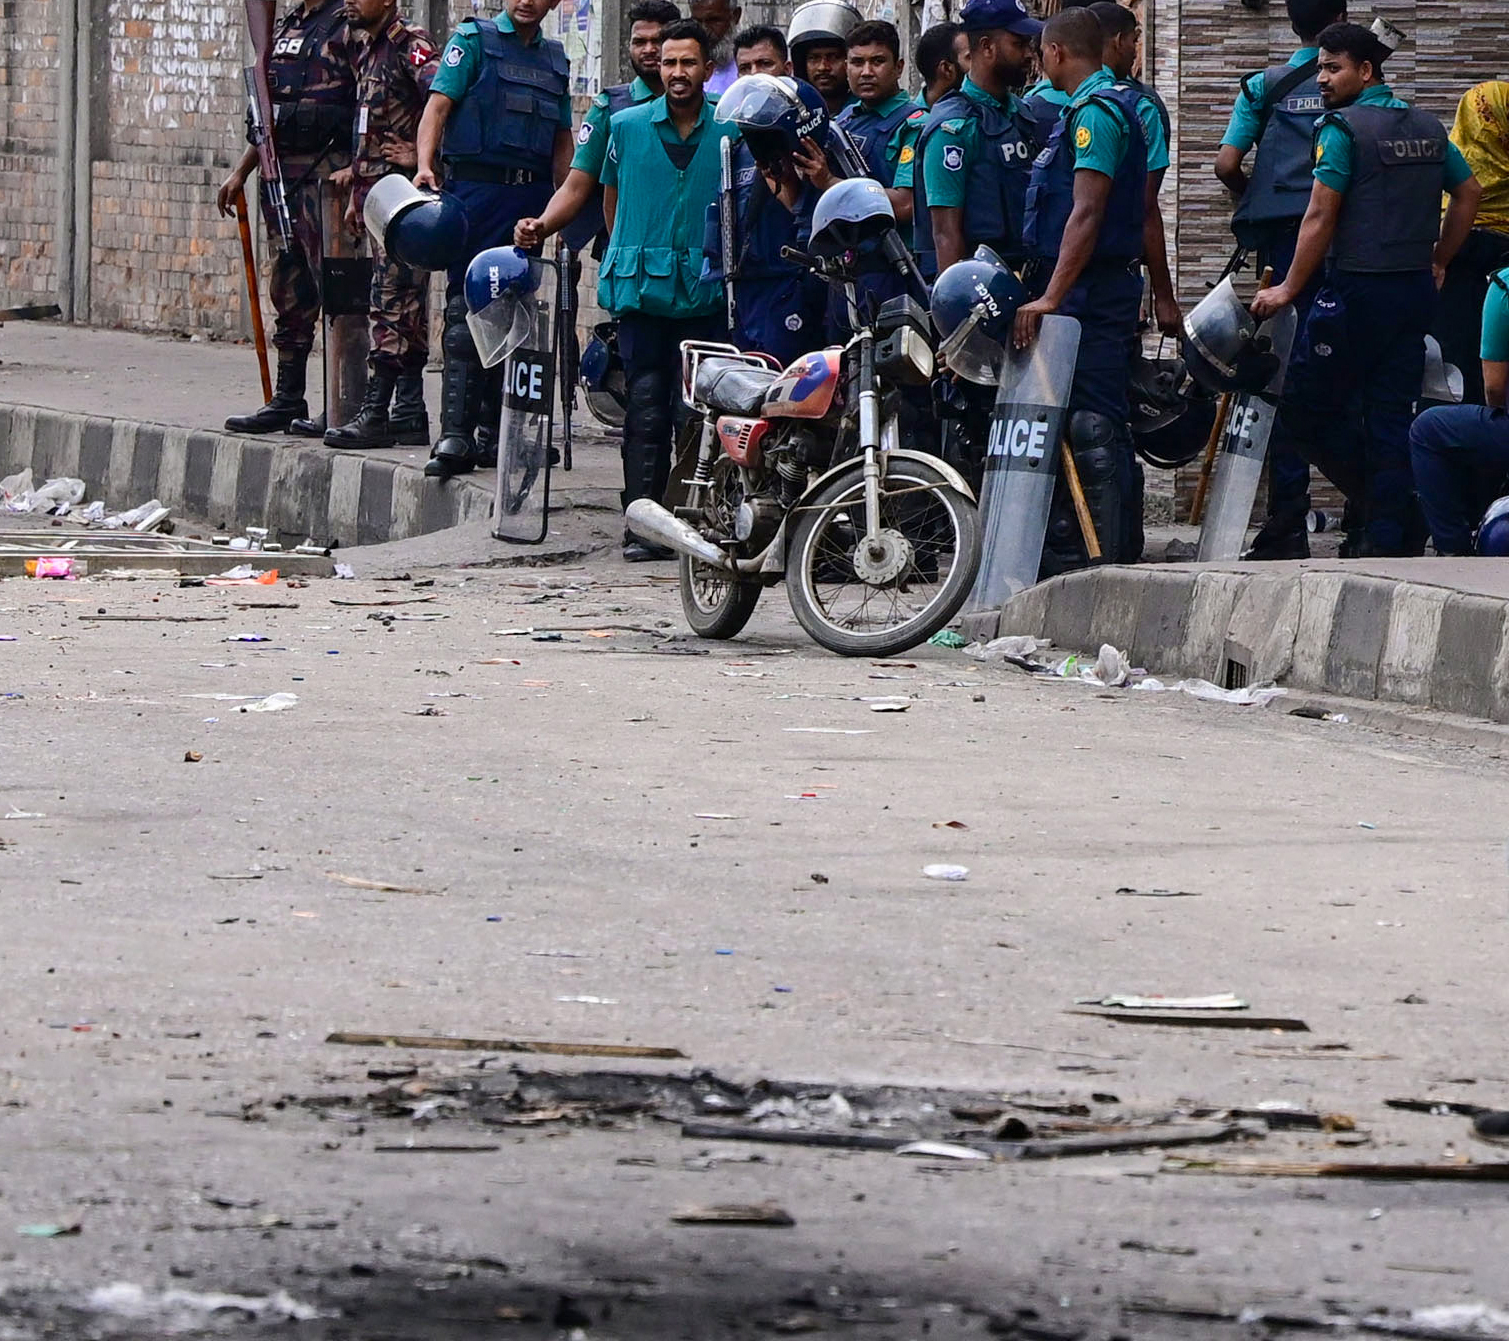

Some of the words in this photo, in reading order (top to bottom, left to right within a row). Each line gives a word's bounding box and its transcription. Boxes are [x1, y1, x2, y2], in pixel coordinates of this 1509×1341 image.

[1297, 97, 1324, 109] POLI
[796, 116, 822, 138] POLICE
[489, 265, 500, 299] POLICE
[974, 283, 1001, 317] POLICE
[988, 419, 1049, 458] OLICE
